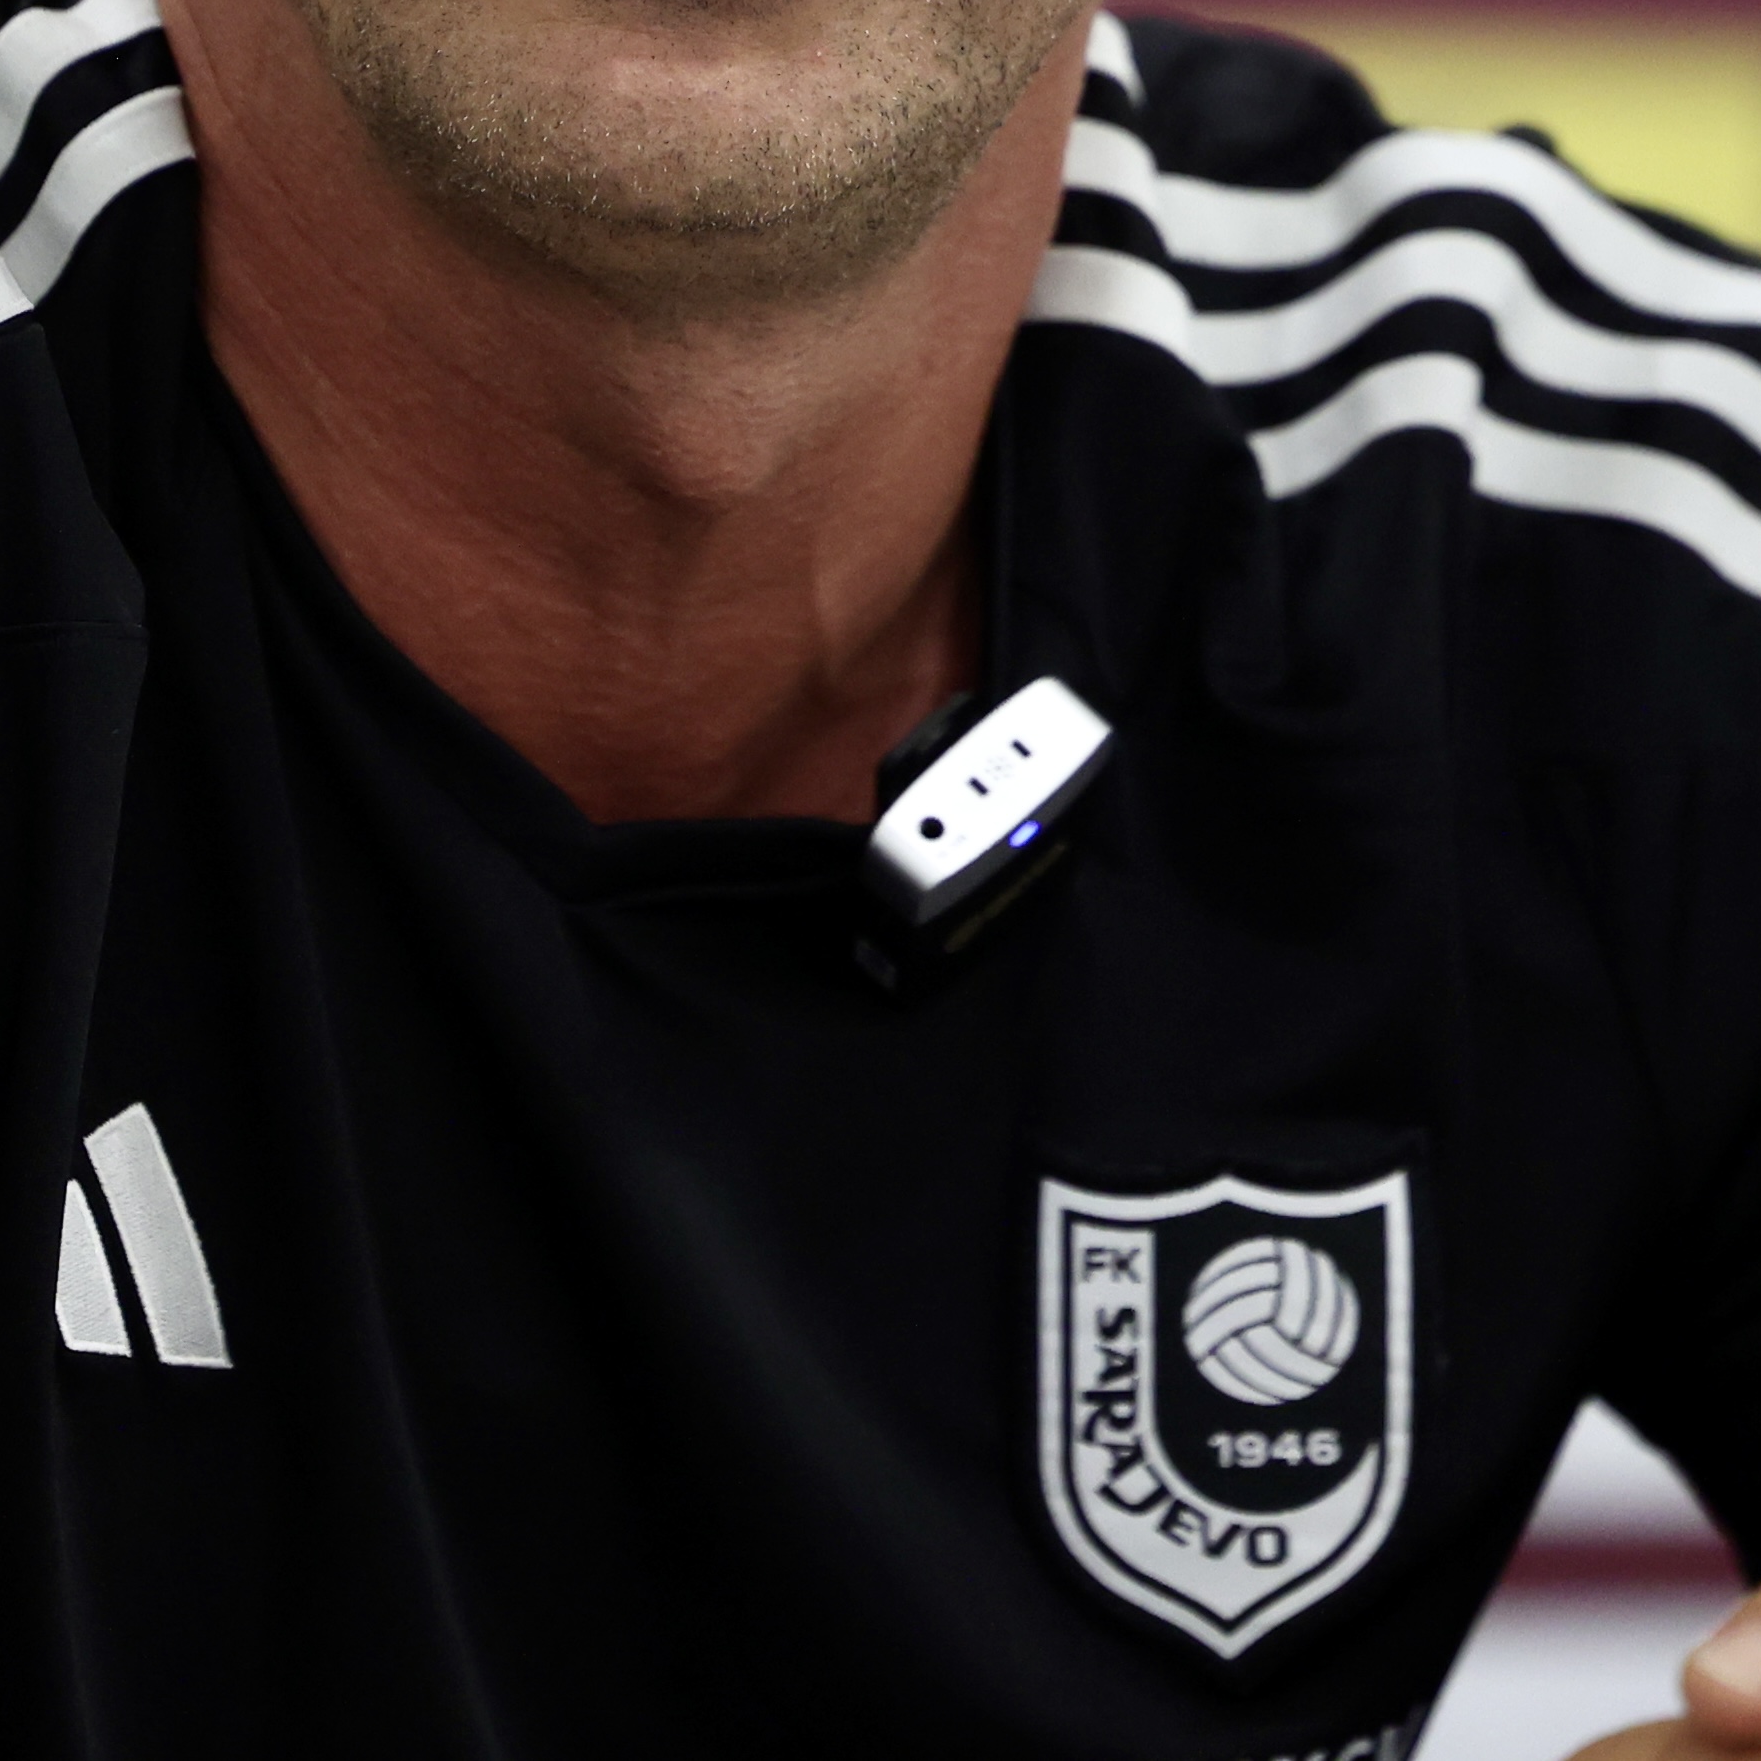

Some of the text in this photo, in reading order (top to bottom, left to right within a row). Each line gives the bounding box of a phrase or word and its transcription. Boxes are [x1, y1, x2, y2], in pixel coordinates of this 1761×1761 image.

[1080, 1247, 1287, 1567] FK SARAJEVO
[1208, 1431, 1341, 1469] 1946
